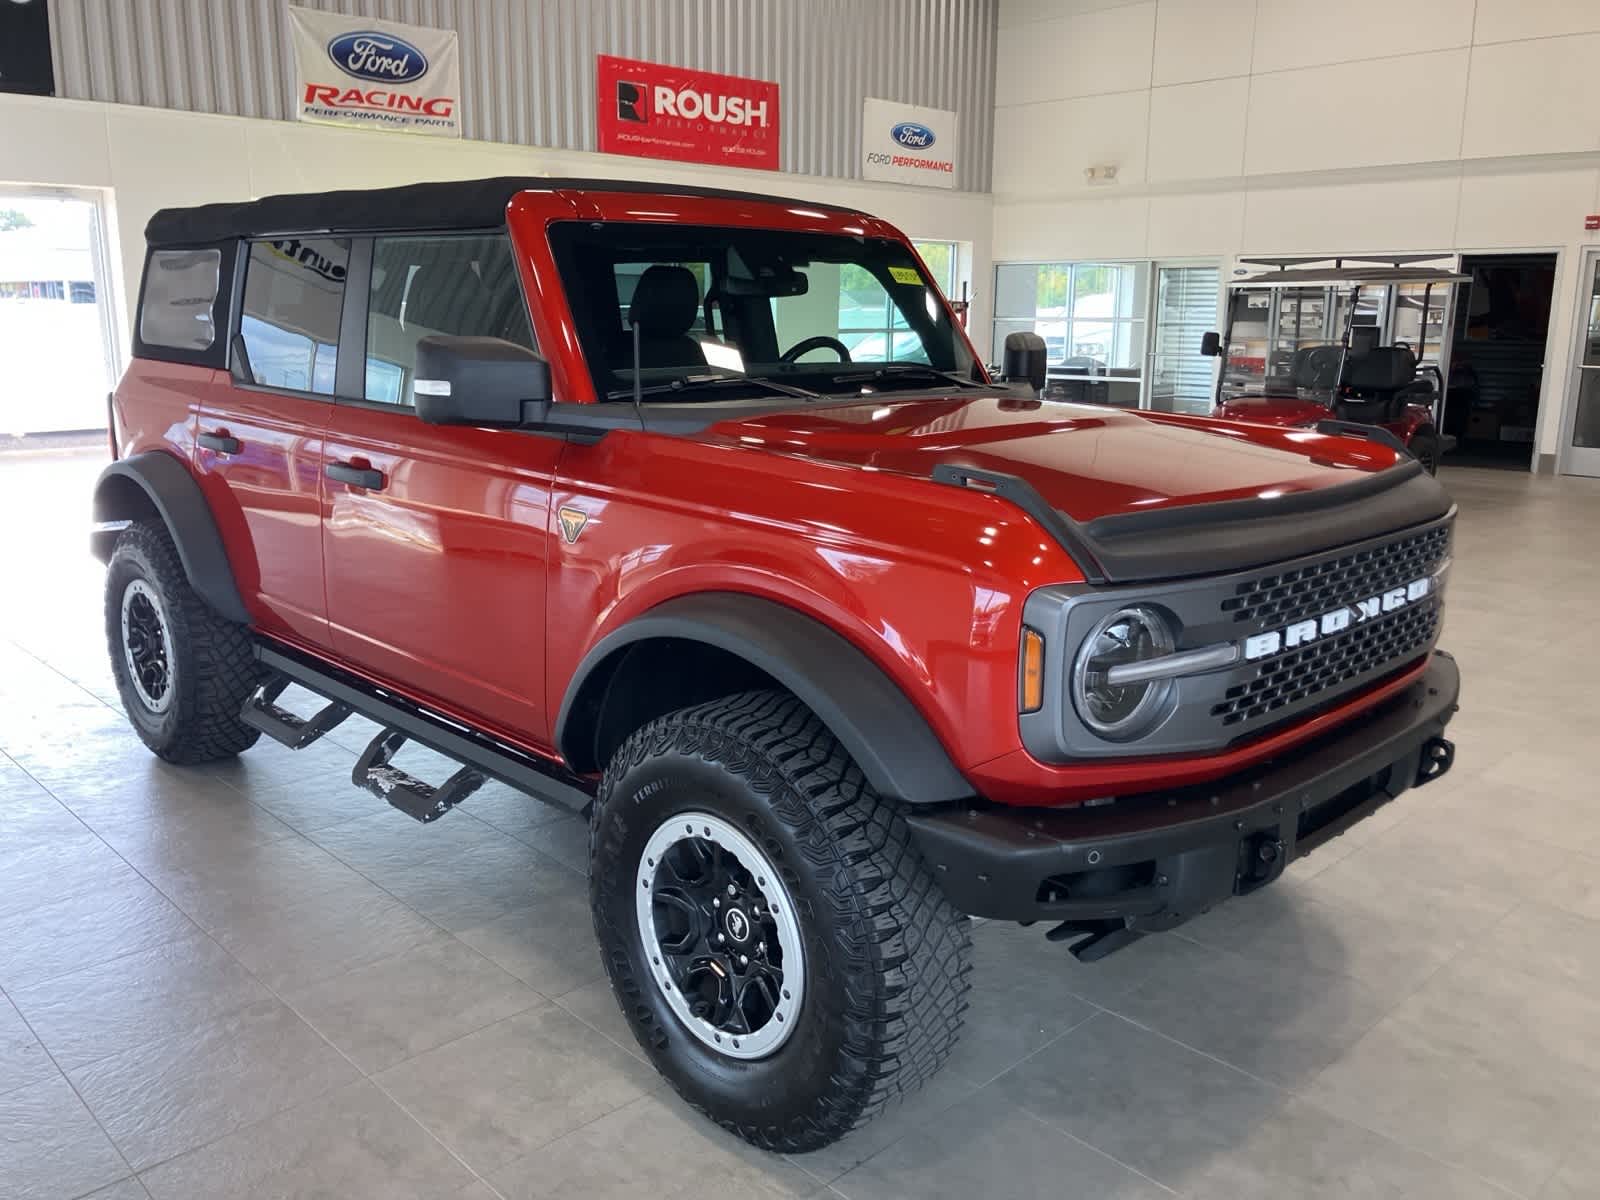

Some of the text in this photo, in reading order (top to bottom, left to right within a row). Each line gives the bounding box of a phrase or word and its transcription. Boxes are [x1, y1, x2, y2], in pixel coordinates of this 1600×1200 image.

[348, 38, 409, 77] Ford
[304, 83, 454, 117] RACING
[305, 107, 455, 127] PERFORMANCE PARTS
[654, 86, 768, 127] ROUSH
[899, 127, 927, 145] Ford
[866, 152, 953, 173] FORD PERFORMANCE
[1245, 577, 1430, 659] BRONCO
